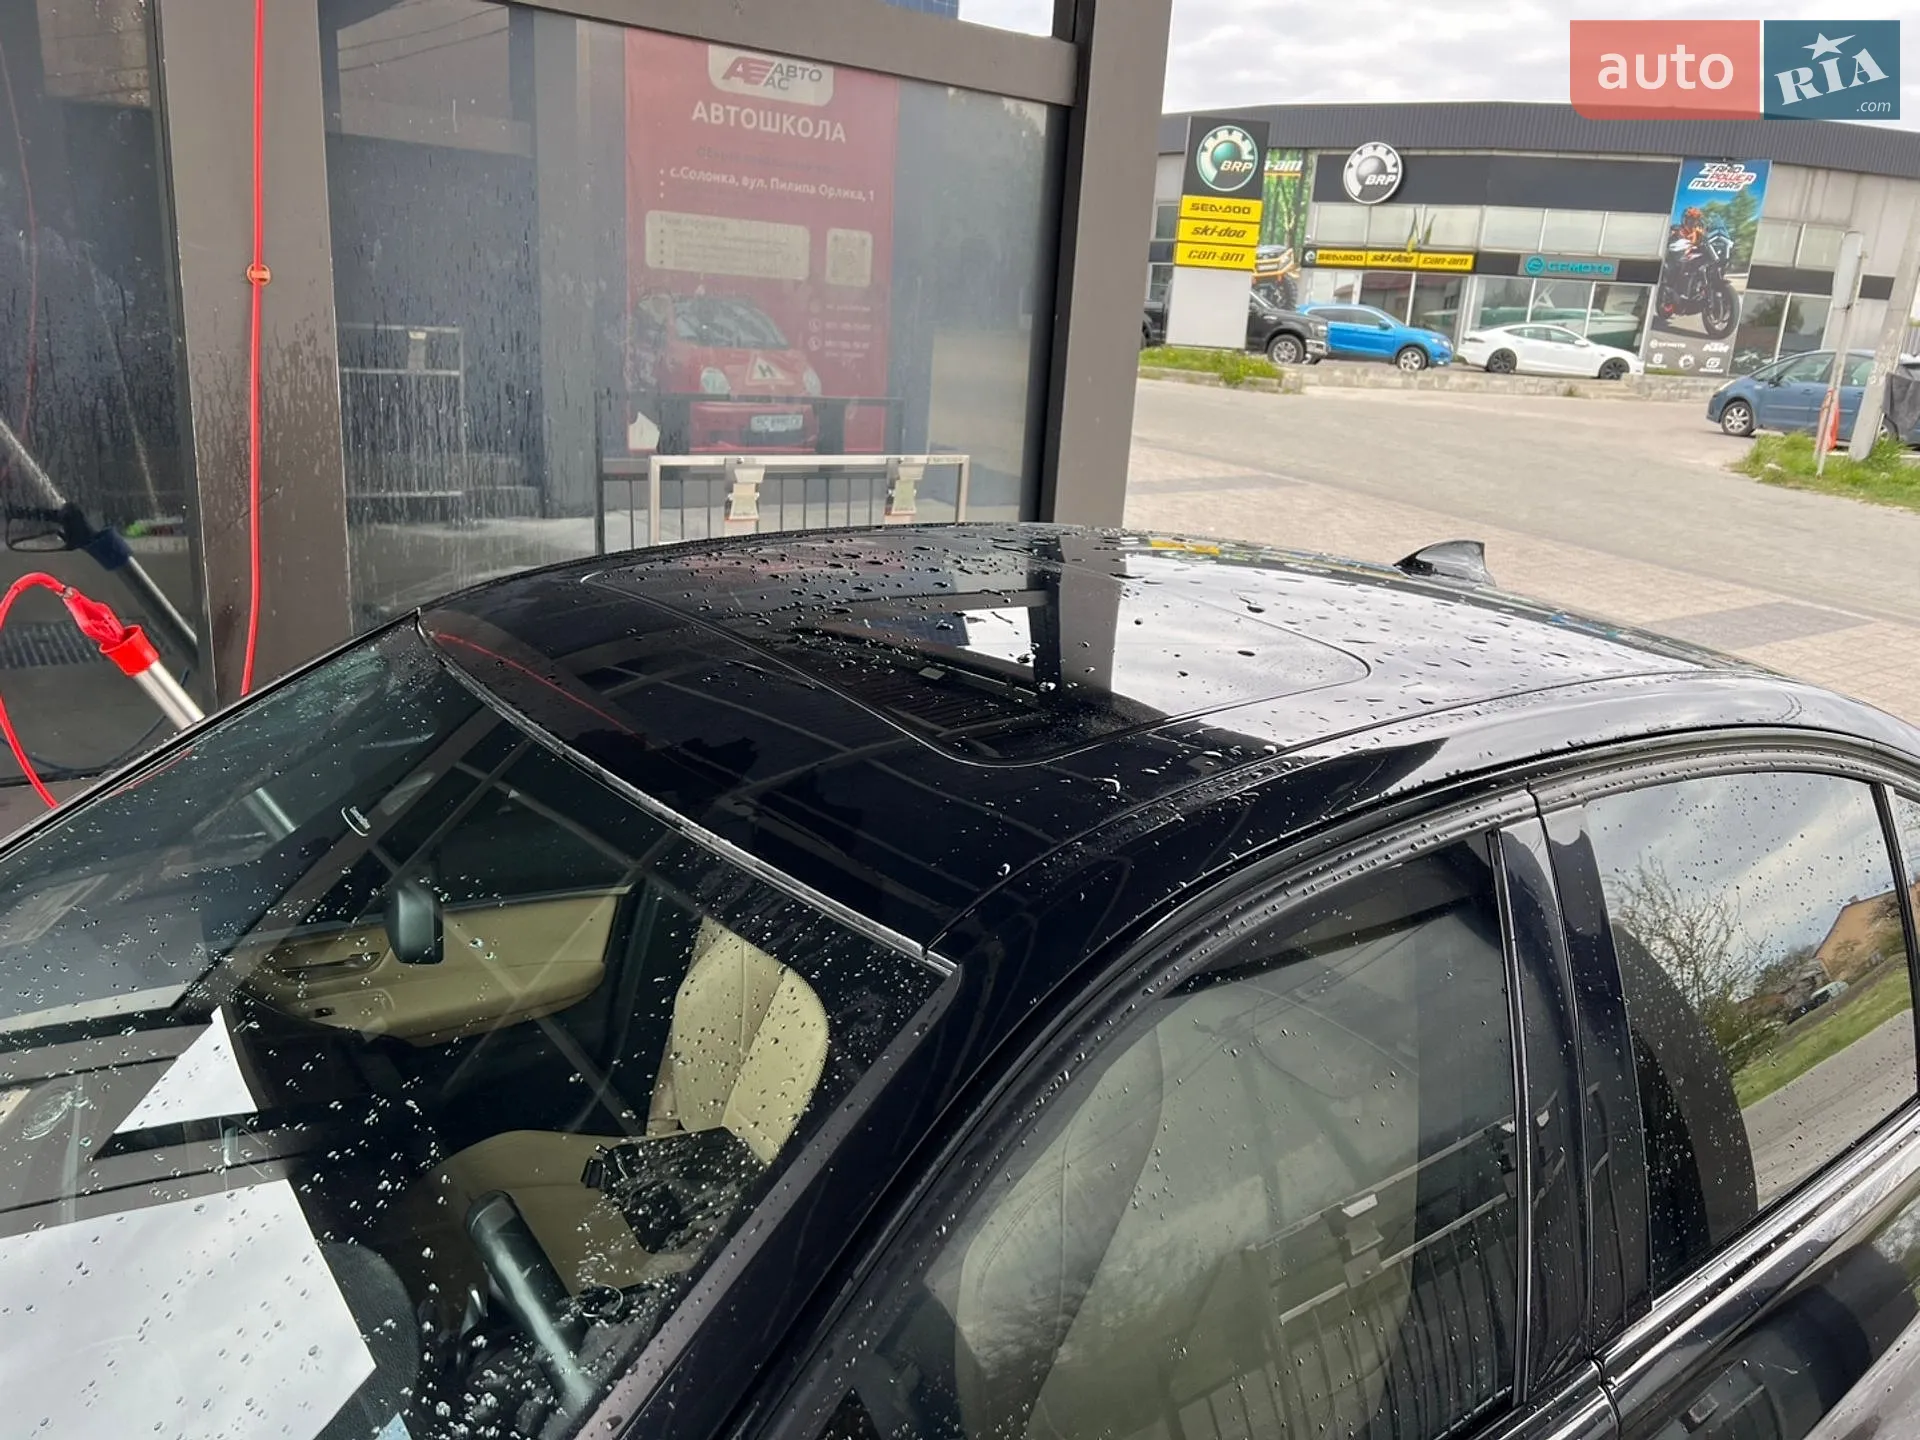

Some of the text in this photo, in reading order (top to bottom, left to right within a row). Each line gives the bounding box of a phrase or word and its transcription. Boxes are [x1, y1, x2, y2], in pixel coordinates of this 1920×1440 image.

[772, 62, 823, 83] АВТО
[762, 76, 790, 91] АС
[692, 100, 846, 143] АВТОШКОЛА
[1220, 160, 1253, 172] BRP
[770, 177, 816, 195] Пилипа
[1365, 174, 1396, 185] BRP
[1192, 225, 1247, 238] ski-doo
[1188, 250, 1245, 262] can-am
